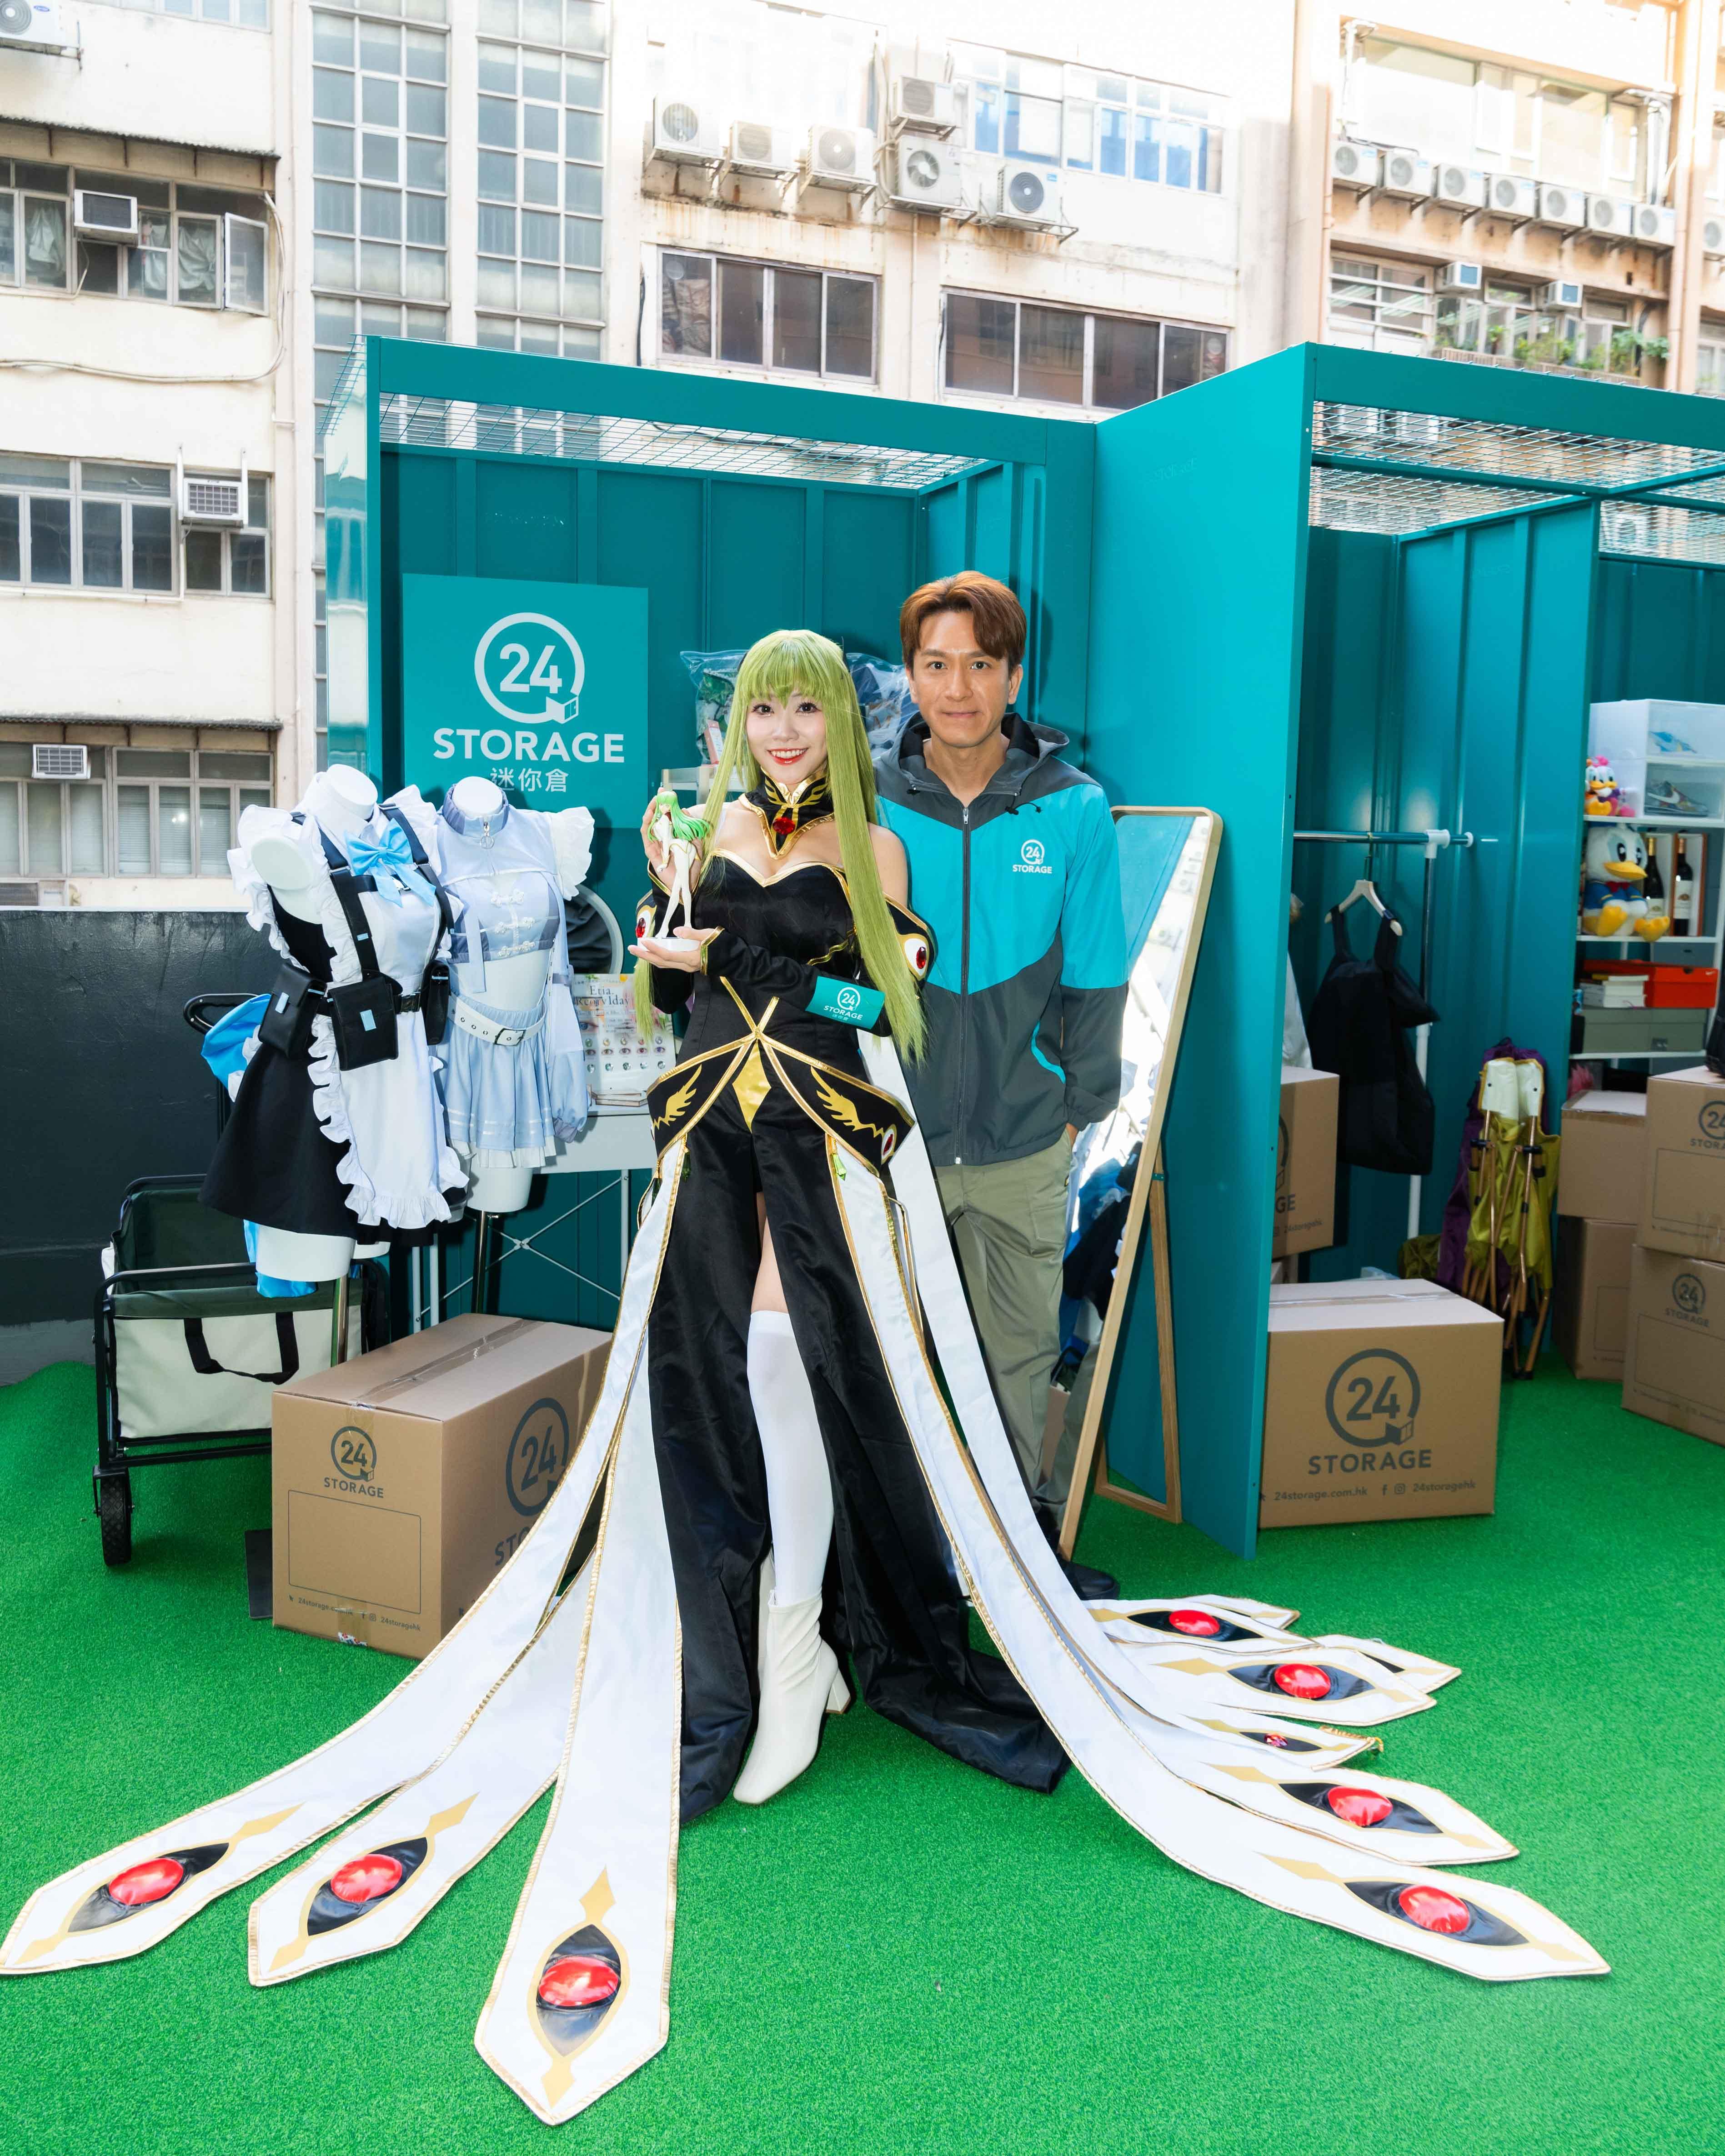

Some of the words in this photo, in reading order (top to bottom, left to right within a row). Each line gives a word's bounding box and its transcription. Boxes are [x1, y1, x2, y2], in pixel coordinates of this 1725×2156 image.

[500, 643, 562, 694] 24
[433, 728, 624, 763] STORAGE
[491, 767, 569, 793] 迷你倉
[1026, 846, 1040, 858] 24
[1013, 865, 1052, 874] STORAGE
[842, 993, 855, 1005] 24
[823, 1005, 863, 1020] STORAGE
[1346, 1376, 1400, 1421] 24
[341, 1440, 367, 1467] 24
[521, 1425, 557, 1491] 24
[1308, 1449, 1432, 1475] STORAGE
[323, 1477, 384, 1499] STORAGE
[1274, 1486, 1368, 1501] 24storage.com.hk
[1413, 1479, 1476, 1493] 24storagehk
[381, 1616, 421, 1631] 24storagehk
